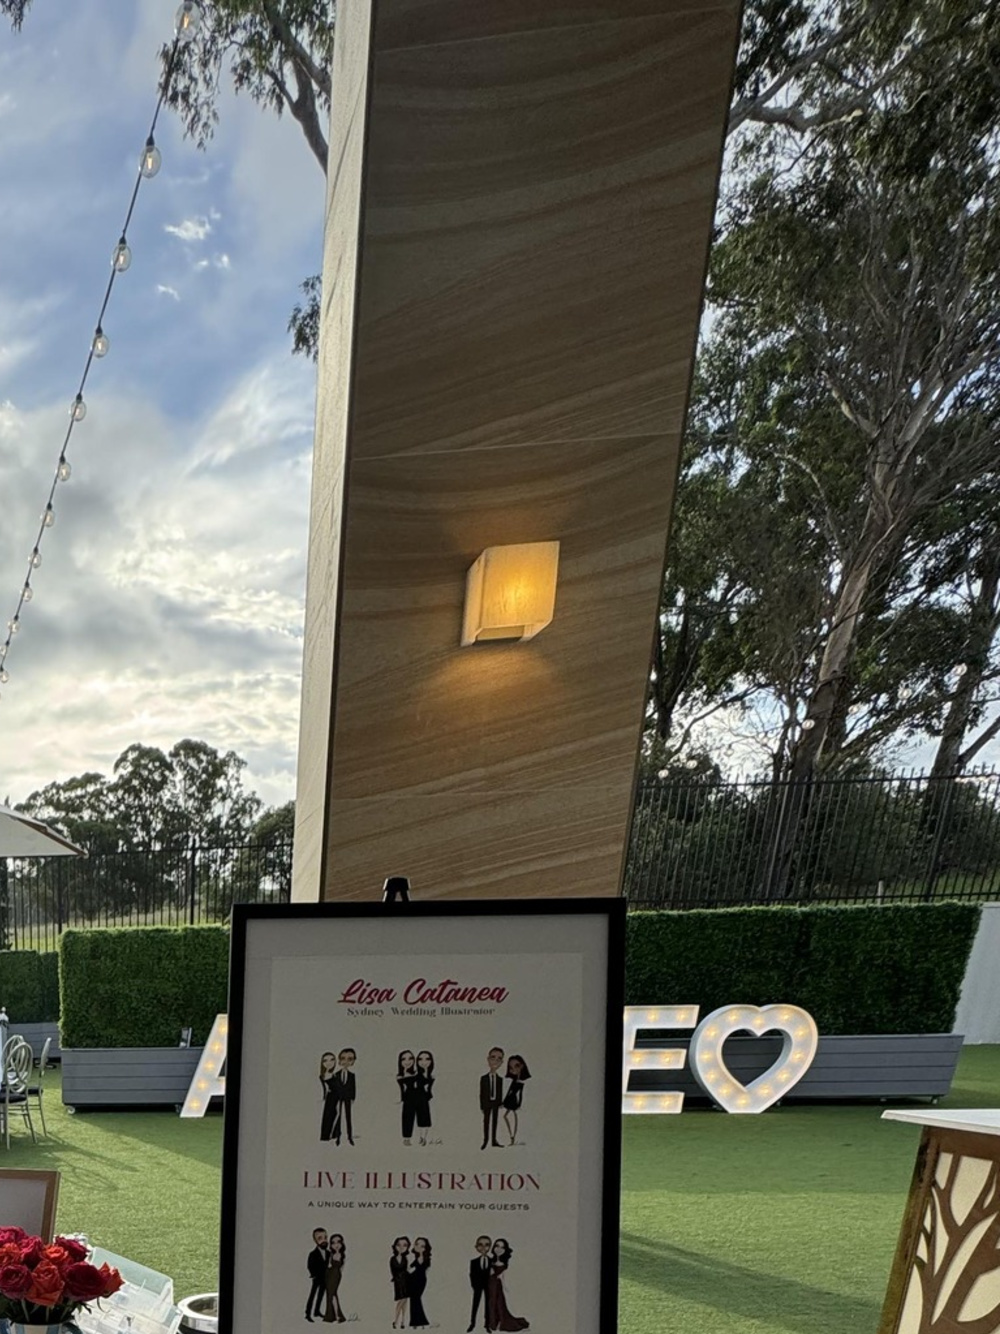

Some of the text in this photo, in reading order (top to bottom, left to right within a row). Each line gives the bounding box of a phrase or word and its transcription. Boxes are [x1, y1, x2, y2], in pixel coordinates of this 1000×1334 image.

[337, 977, 509, 1006] Lisa Catanea
[346, 1007, 495, 1018] Sydney Wedding Illustrator
[303, 1171, 542, 1191] LIVE ILLUSTRATION
[317, 1201, 354, 1209] UNIQUE
[398, 1202, 455, 1210] ENTERTAIN
[488, 1203, 531, 1211] GUESTS
